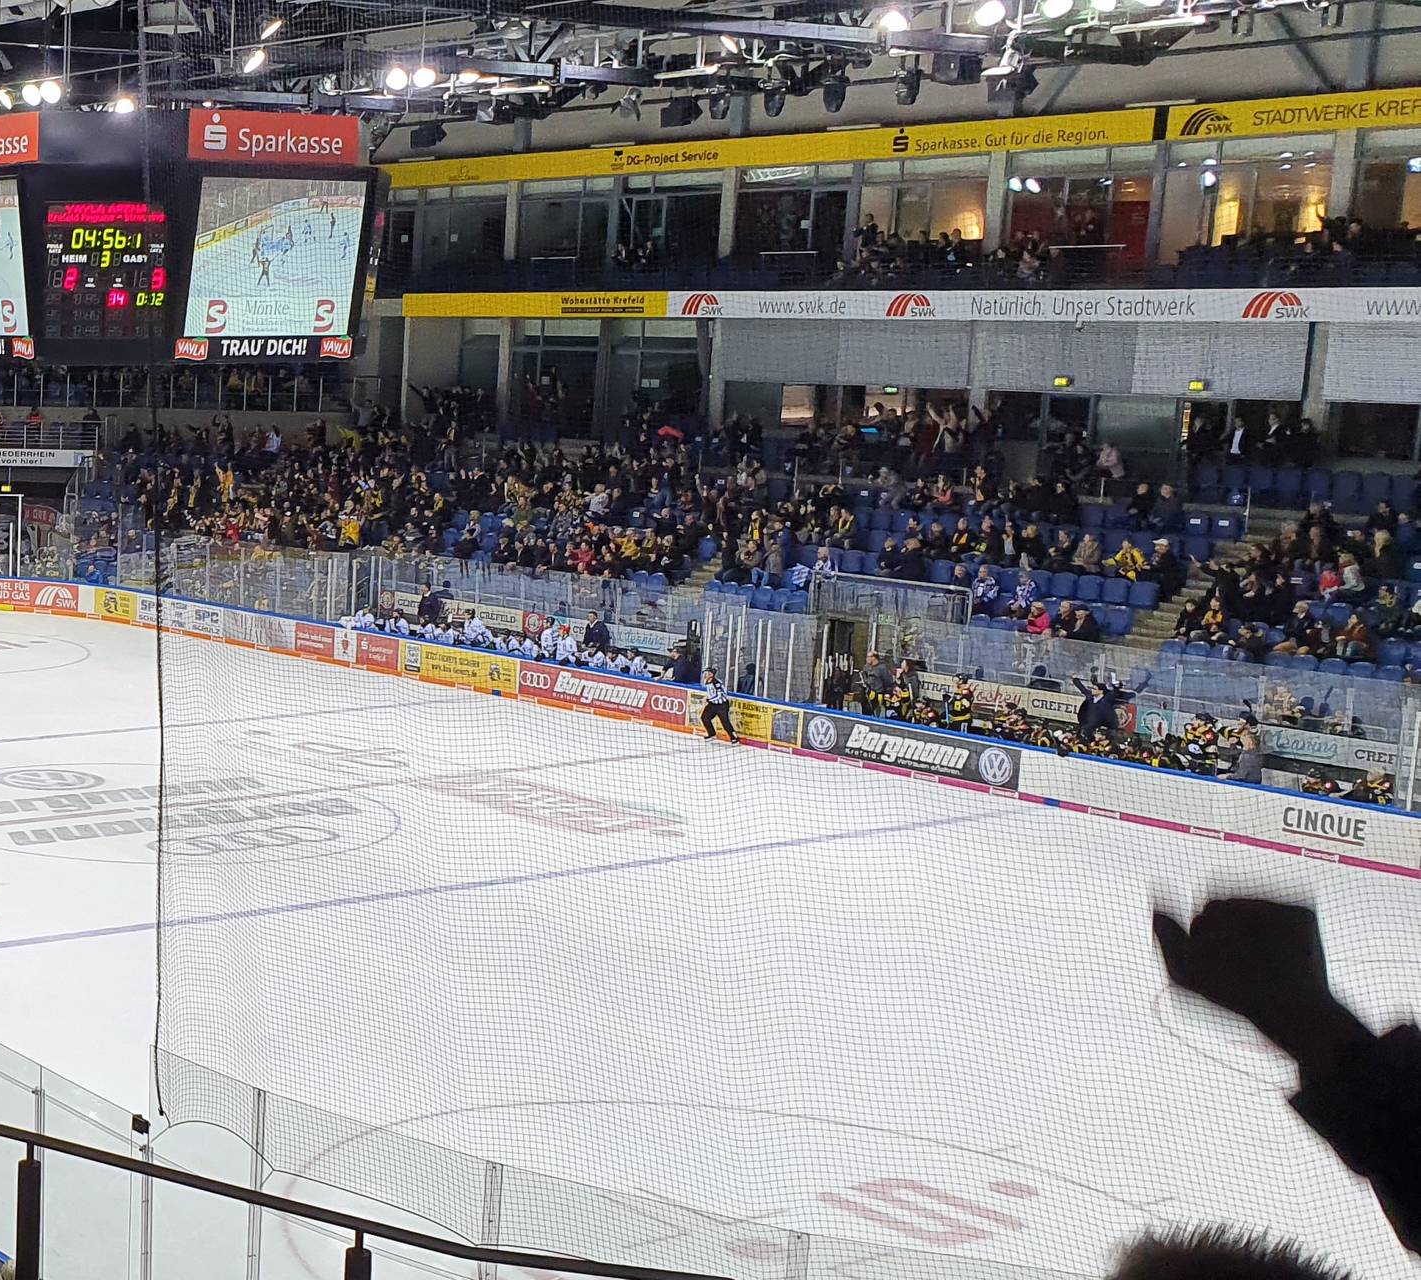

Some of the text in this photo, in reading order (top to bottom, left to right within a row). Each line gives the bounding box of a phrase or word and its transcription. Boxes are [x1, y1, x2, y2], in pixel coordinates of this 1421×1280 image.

[1252, 102, 1370, 126] STADTWERKE
[1205, 121, 1233, 135] SWK
[238, 128, 343, 158] Sparkasse
[914, 127, 1109, 154] Sparkasse. Gut für die Region.
[626, 152, 679, 167] DG-Project
[681, 149, 719, 162] Service
[61, 254, 87, 264] HEIM
[100, 250, 111, 268] 3
[136, 292, 164, 306] 0:12
[613, 295, 645, 305] Krefeld
[758, 296, 847, 315] www.swk.de
[970, 295, 1195, 317] Natürlich. Unser Stadtwerk
[245, 299, 290, 316] Mönke
[701, 306, 723, 316] SWK
[910, 305, 936, 318] SWK
[1275, 305, 1311, 319] SWK
[13, 339, 33, 355] YAYLA
[177, 340, 206, 357] YAYLA
[221, 338, 307, 357] TRAU' DICH!
[321, 339, 350, 355] YAYLA
[20, 457, 43, 465] hier!
[14, 581, 31, 592] FÜR
[11, 590, 31, 601] GAS
[55, 598, 77, 609] SWK
[140, 599, 156, 612] SP
[194, 609, 219, 624] SPC
[479, 611, 516, 625] CREFELD
[192, 625, 221, 635] SCHULZ
[553, 670, 648, 708] Borgmann
[845, 723, 970, 770] Borgmann
[1281, 805, 1367, 841] CINQUE
